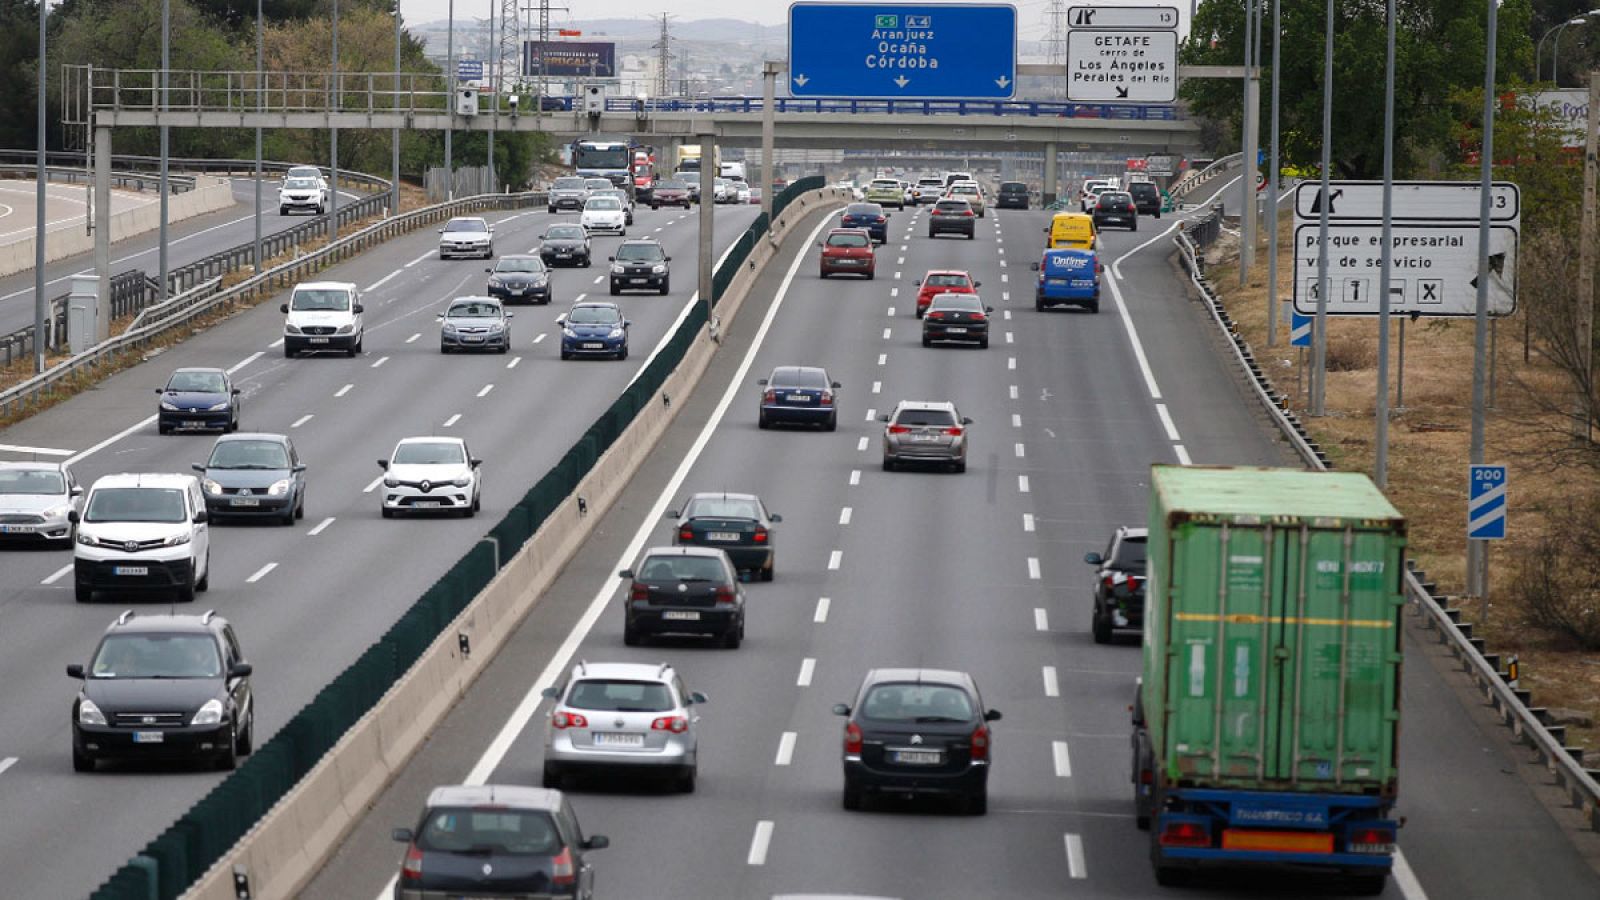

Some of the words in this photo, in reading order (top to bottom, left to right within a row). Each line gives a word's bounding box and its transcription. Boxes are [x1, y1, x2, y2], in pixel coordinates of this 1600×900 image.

[907, 16, 929, 27] A-4
[1160, 13, 1172, 22] 13
[871, 29, 934, 42] Aranjuez
[1094, 36, 1151, 46] GETAFE
[878, 41, 926, 54] Ocaña
[1100, 49, 1128, 57] cerro
[1133, 48, 1145, 57] de
[865, 54, 938, 69] Córdoba
[1079, 60, 1102, 70] Los
[1110, 57, 1165, 72] Ángeles
[1074, 72, 1124, 82] Perales
[1130, 75, 1146, 83] del
[1306, 236, 1360, 248] paque
[1369, 235, 1464, 248] epresarial
[1339, 255, 1357, 267] de
[1366, 256, 1432, 268] sevicio
[1475, 470, 1502, 481] 200
